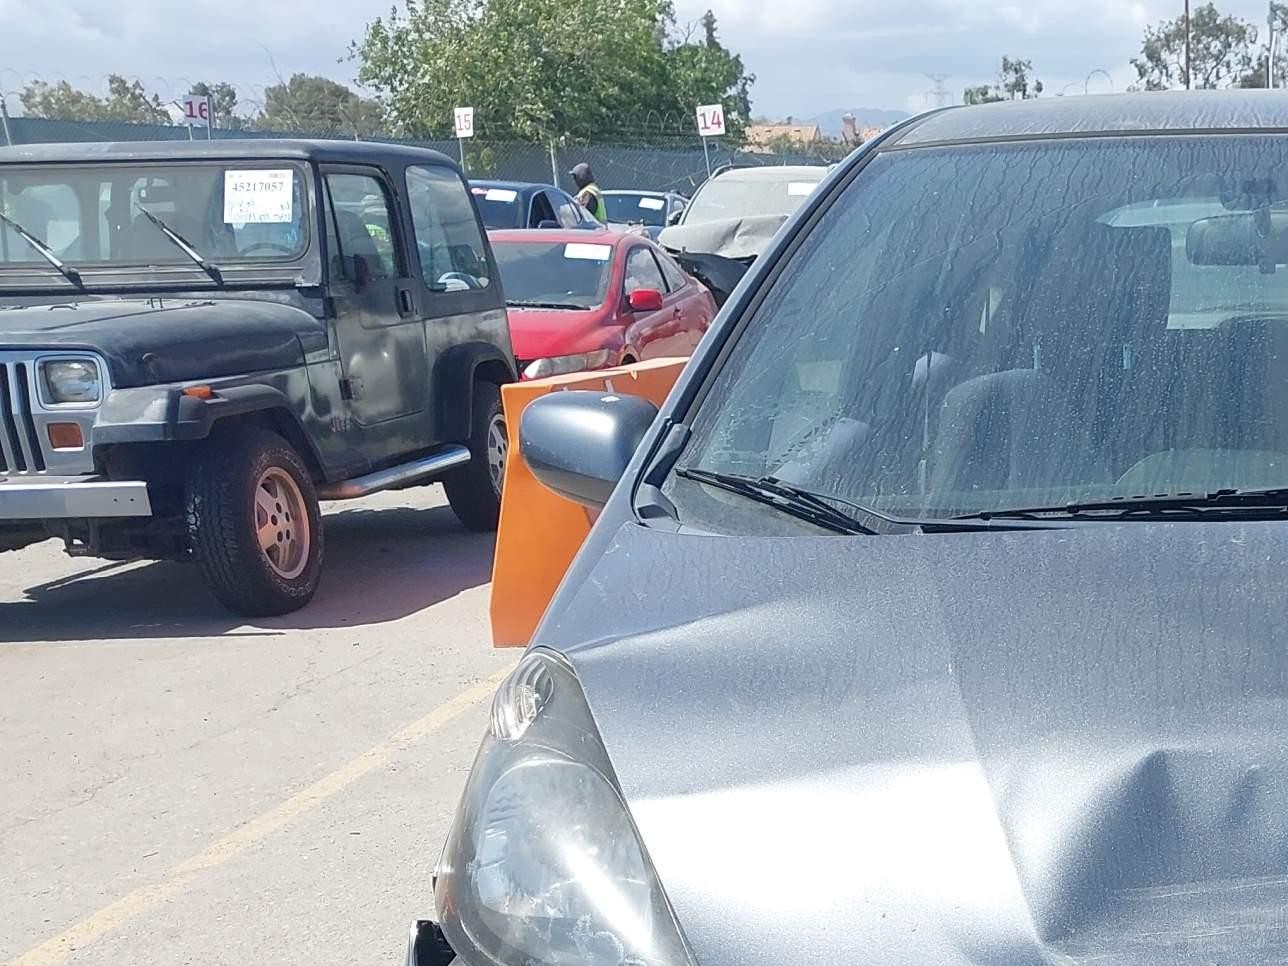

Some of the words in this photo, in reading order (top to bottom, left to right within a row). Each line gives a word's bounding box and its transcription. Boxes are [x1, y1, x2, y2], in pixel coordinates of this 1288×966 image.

[185, 101, 208, 120] 16
[456, 113, 471, 131] 15
[699, 110, 722, 130] 14
[231, 181, 284, 193] 45217057
